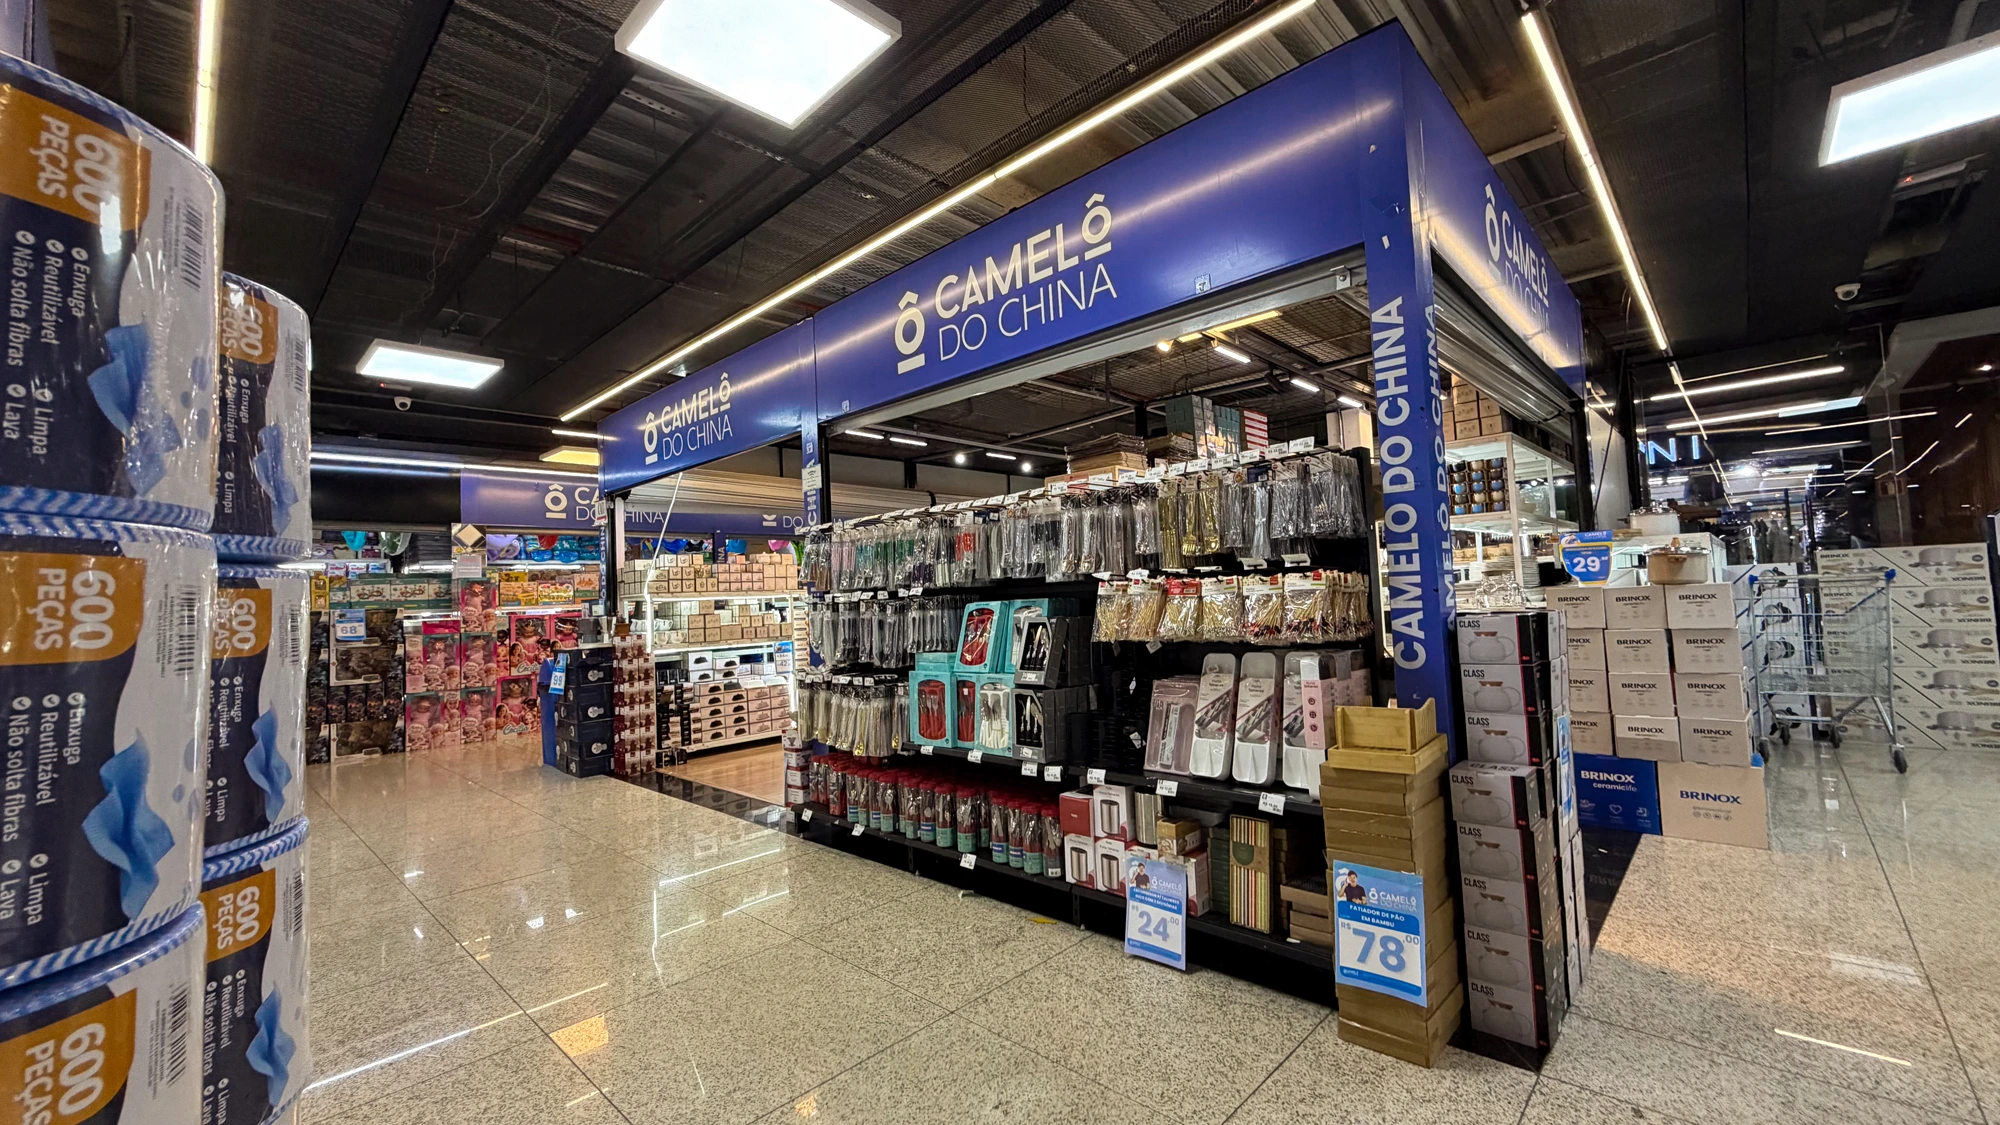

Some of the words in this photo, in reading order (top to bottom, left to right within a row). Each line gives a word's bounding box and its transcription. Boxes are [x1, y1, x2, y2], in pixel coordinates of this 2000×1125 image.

[29, 114, 72, 200] PEÇAS
[73, 132, 121, 214] 600
[11, 246, 34, 277] Não
[935, 193, 1112, 319] CAMELÔ
[1502, 210, 1549, 308] CAMELÔ
[10, 278, 32, 318] solta
[40, 254, 64, 345] Reutilizável
[67, 262, 90, 317] Enxuga
[939, 313, 987, 361] DO
[998, 263, 1118, 338] CHINA
[7, 320, 31, 366] fibras
[1371, 296, 1411, 426] CHINA
[1424, 304, 1442, 427] CHINA
[240, 389, 249, 424] Enxuga
[661, 372, 731, 434] CAMELÔ
[4, 401, 25, 440] Lava
[27, 407, 53, 455] Limpa
[662, 432, 684, 461] DO
[686, 414, 733, 451] CHINA
[1380, 435, 1416, 494] DO
[1434, 435, 1447, 492] DO
[224, 482, 235, 514] Limpa
[782, 516, 804, 529] DO
[1384, 503, 1427, 670] CAMELO
[1557, 595, 1591, 603] BRINOX
[1615, 595, 1651, 603] BRINOX
[1678, 593, 1718, 601] BRINOX
[26, 568, 67, 650] PEÇAS
[70, 569, 116, 650] 600
[231, 598, 257, 650] 600
[1459, 620, 1480, 628] CLASS
[341, 626, 357, 635] 68
[553, 675, 563, 686] 99
[1463, 669, 1485, 678] CLASS
[1621, 682, 1658, 690] BRINOX
[1687, 682, 1727, 690] BRINOX
[218, 688, 230, 747] Reutilizável
[233, 686, 242, 722] Enxuga
[8, 714, 28, 747] Não
[63, 708, 86, 765] Enxuga
[1468, 717, 1490, 726] CLASS
[1627, 726, 1664, 734] BRINOX
[1693, 727, 1733, 737] BRINOX
[6, 750, 27, 789] solta
[36, 712, 59, 806] Reutilizável
[1469, 763, 1519, 772] CLASS
[1452, 775, 1474, 785] CLASS
[1580, 770, 1635, 784] BRINOX
[1593, 782, 1638, 792] ceramiclife
[216, 788, 228, 822] Limpa
[1680, 790, 1742, 805] BRINOX
[3, 793, 26, 842] fibras
[1459, 826, 1482, 838] CLASS
[0, 879, 21, 920] Lava
[24, 873, 49, 926] Limpa
[1159, 879, 1183, 891] CAMELÔ
[1379, 891, 1417, 906] CAMELÔ
[1464, 877, 1487, 890] CLASS
[212, 893, 234, 950] PEÇAS
[236, 886, 260, 943] 600
[1349, 904, 1380, 917] FATIADOR
[1381, 911, 1389, 919] DE
[1390, 912, 1405, 922] PÃO
[1361, 915, 1371, 923] EM
[1371, 917, 1395, 928] BAMBU
[1380, 899, 1392, 908] DO
[1392, 901, 1417, 913] CHINA
[1340, 921, 1352, 931] R$
[1467, 929, 1490, 943] CLASS
[204, 991, 217, 1018] Não
[236, 978, 247, 1018] Enxuga
[1471, 982, 1494, 996] CLASS
[204, 1019, 216, 1045] solta
[220, 985, 233, 1049] Reutilizável
[58, 1022, 106, 1116] 600
[203, 1046, 216, 1076] fibras
[203, 1097, 215, 1125] Lava
[217, 1089, 230, 1125] Limpa
